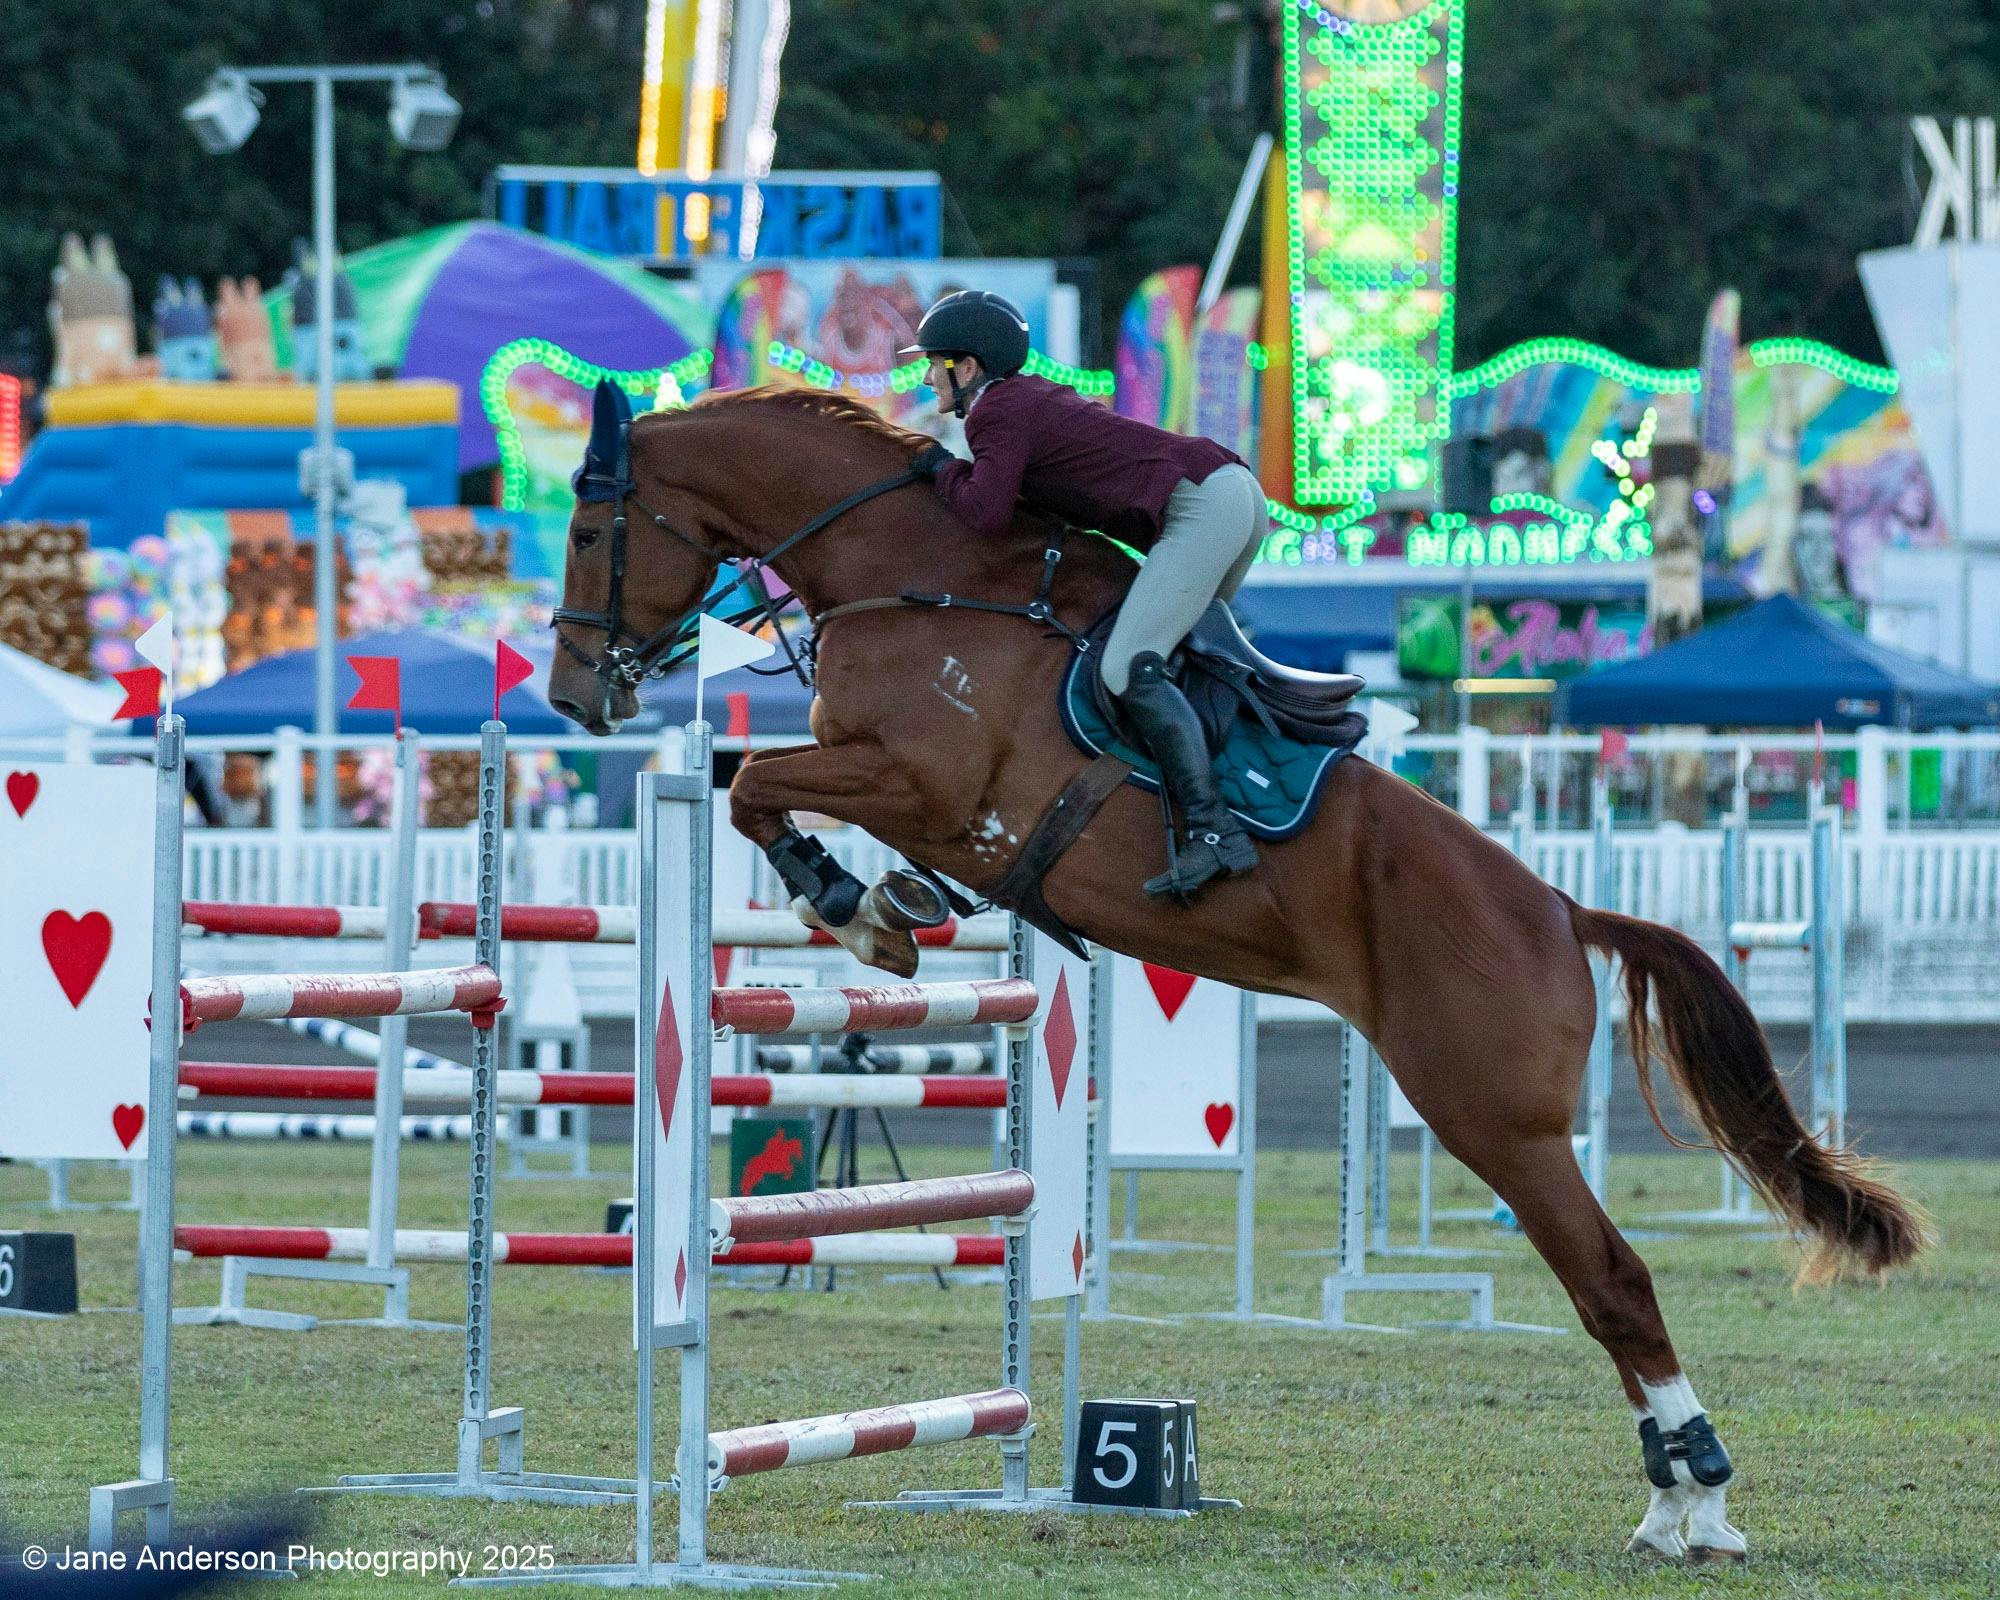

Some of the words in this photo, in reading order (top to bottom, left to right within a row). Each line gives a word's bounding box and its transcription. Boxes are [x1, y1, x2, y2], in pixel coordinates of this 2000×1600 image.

[1092, 1421, 1138, 1489] 5
[1163, 1420, 1175, 1488] 5
[1184, 1415, 1198, 1482] A
